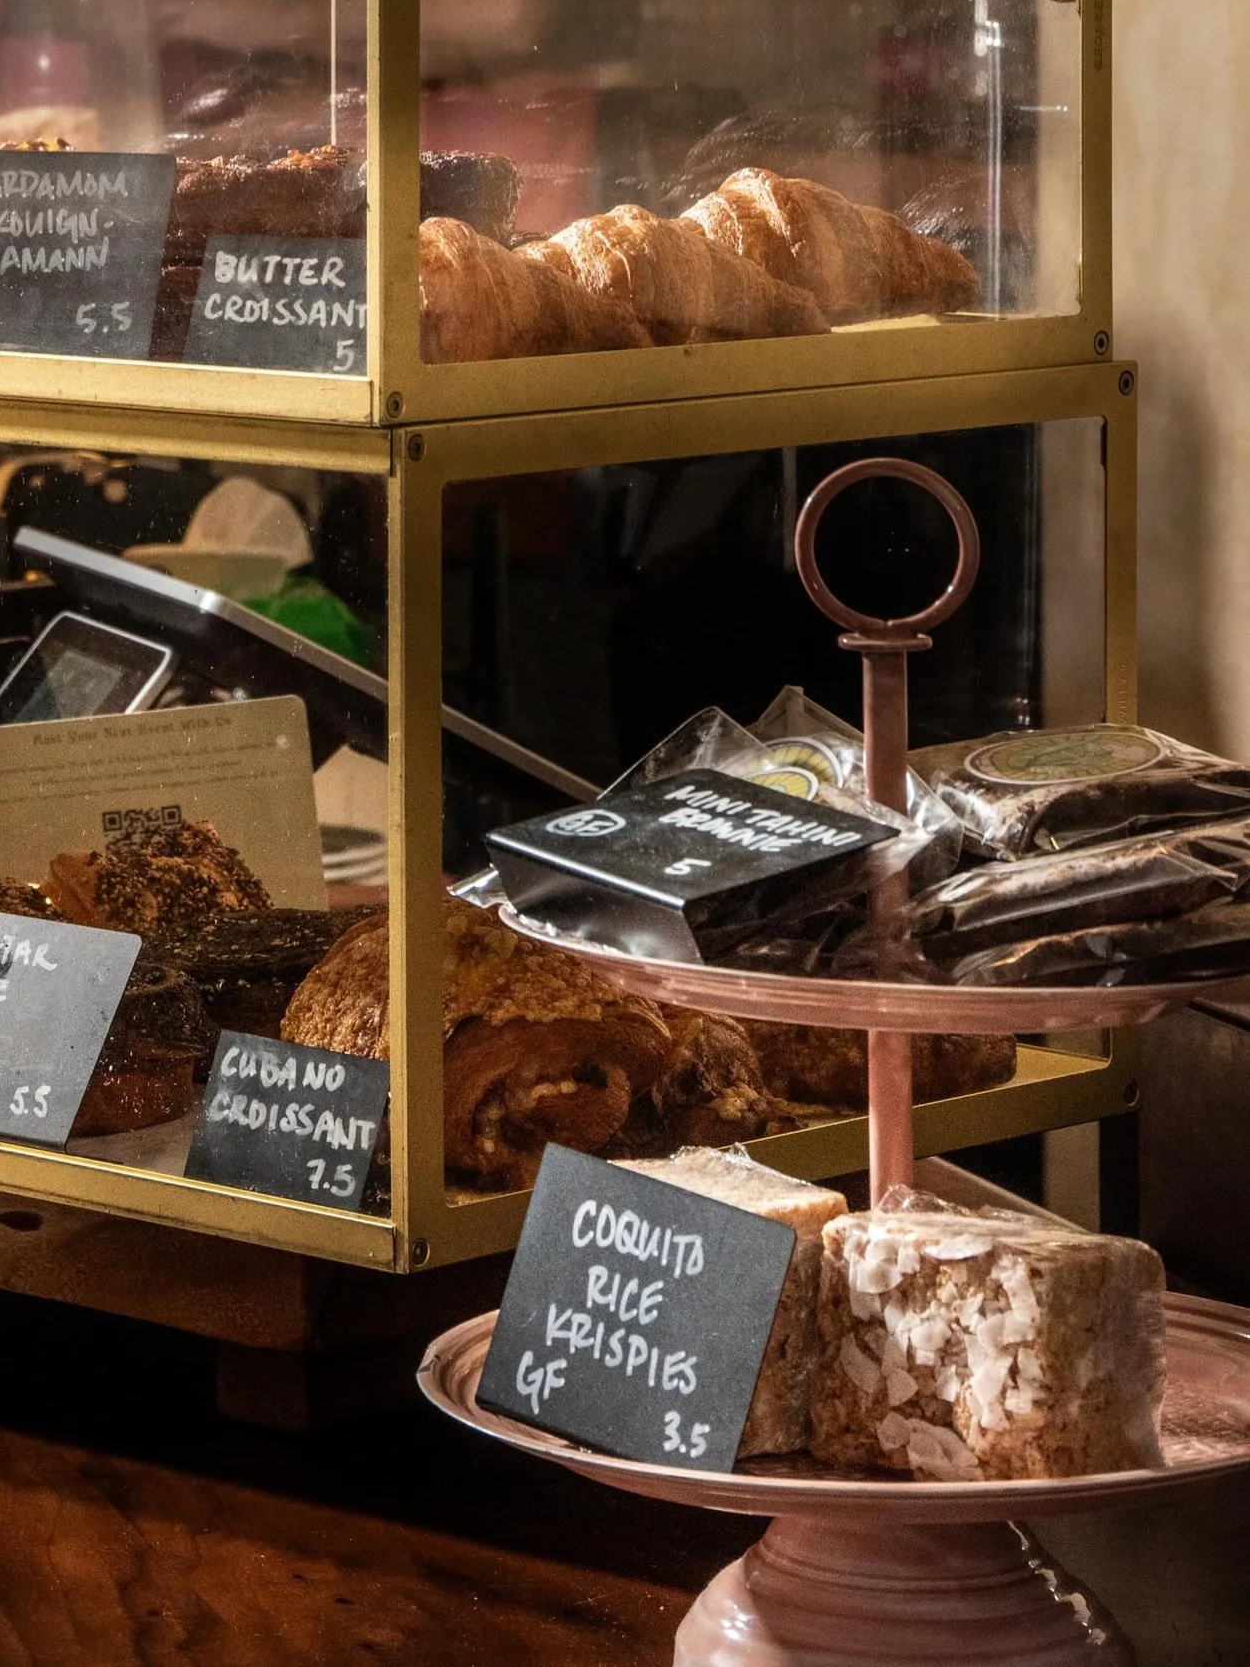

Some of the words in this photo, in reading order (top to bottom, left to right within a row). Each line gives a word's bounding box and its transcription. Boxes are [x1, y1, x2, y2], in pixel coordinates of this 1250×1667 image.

[0, 236, 110, 275] AMANN
[214, 250, 347, 288] BUTTER
[76, 301, 132, 334] 5.5
[204, 292, 367, 329] CROISSANT
[332, 339, 355, 372] 5
[658, 807, 803, 852] BROWNIE
[664, 785, 752, 815] MINI
[745, 809, 862, 847] TAHINI
[664, 857, 712, 876] 5
[9, 1085, 52, 1118] 5.5
[206, 1090, 376, 1150] CROISSANT
[307, 1158, 356, 1197] 7.5
[572, 1199, 704, 1279] COQUITO
[586, 1265, 665, 1325] RICE
[546, 1303, 698, 1395] KRISPIES
[516, 1350, 568, 1415] GF
[662, 1410, 711, 1458] 3.5
